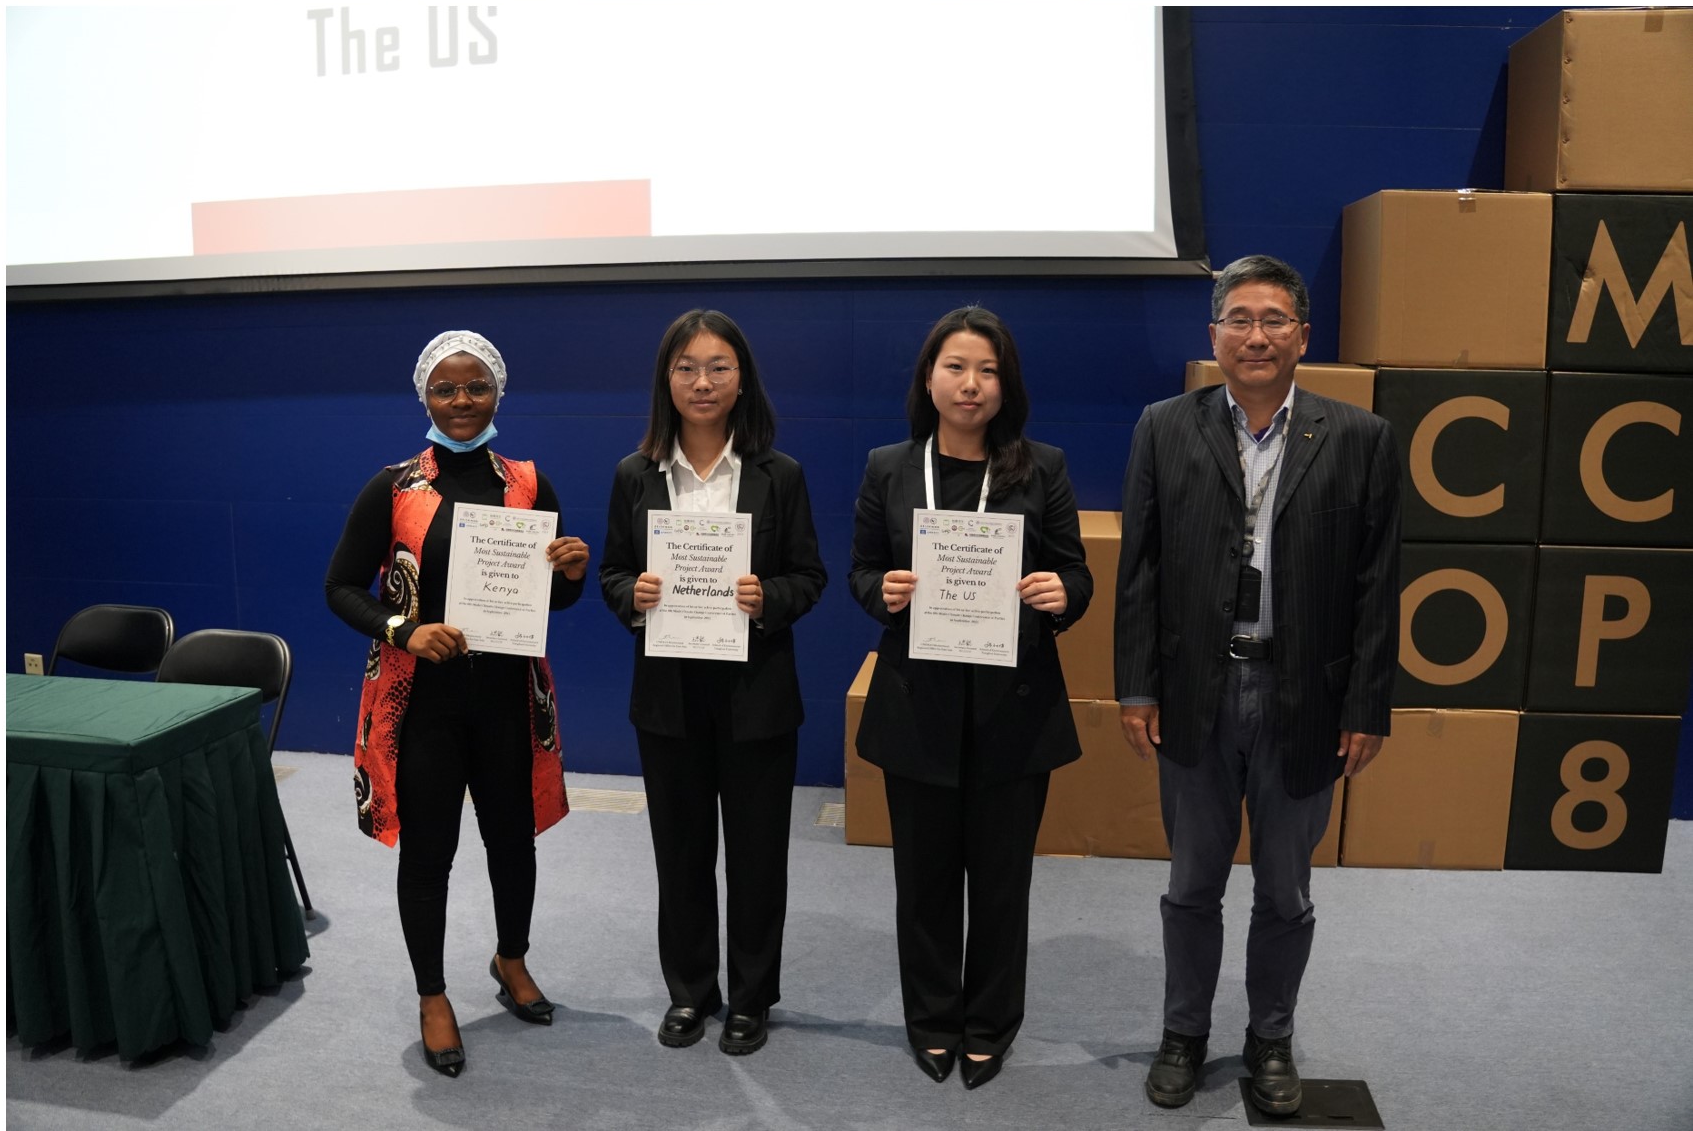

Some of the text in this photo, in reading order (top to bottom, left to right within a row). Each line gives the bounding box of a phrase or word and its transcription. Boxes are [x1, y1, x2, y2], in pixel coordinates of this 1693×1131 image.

[307, 6, 498, 77] The US
[1567, 219, 1693, 349] M
[1409, 395, 1682, 523] C C
[472, 536, 486, 544] The
[487, 538, 527, 548] Certificate
[683, 543, 723, 551] Certificate
[474, 547, 530, 559] Most Sustainable
[950, 544, 992, 553] Certificate
[477, 558, 526, 569] Project Award
[689, 554, 727, 562] Sustainable
[937, 554, 997, 565] Most Sustainable
[675, 564, 723, 573] Project Award
[941, 565, 992, 576] Project Award
[954, 578, 976, 586] given
[483, 581, 518, 596] Kenya
[672, 585, 734, 597] Netherlands
[940, 589, 976, 600] The US
[1398, 568, 1652, 688] O P
[1550, 739, 1631, 850] 8
